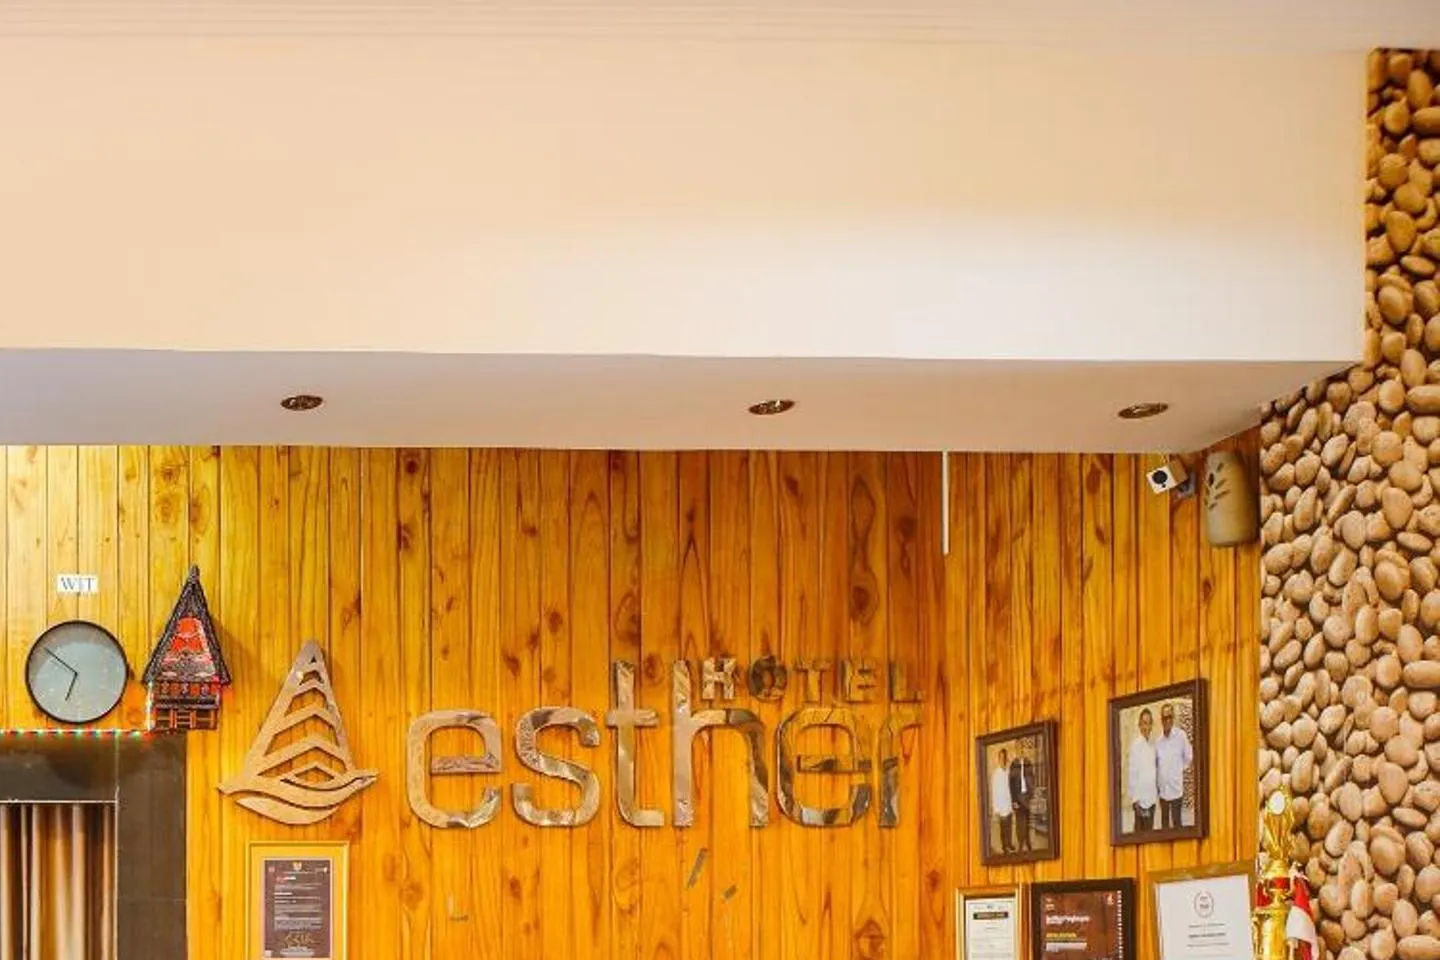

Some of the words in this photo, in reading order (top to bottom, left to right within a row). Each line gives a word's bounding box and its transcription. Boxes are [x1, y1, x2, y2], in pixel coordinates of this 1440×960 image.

[60, 577, 97, 592] WIT
[701, 655, 922, 703] HOTEL
[406, 658, 923, 829] esther
